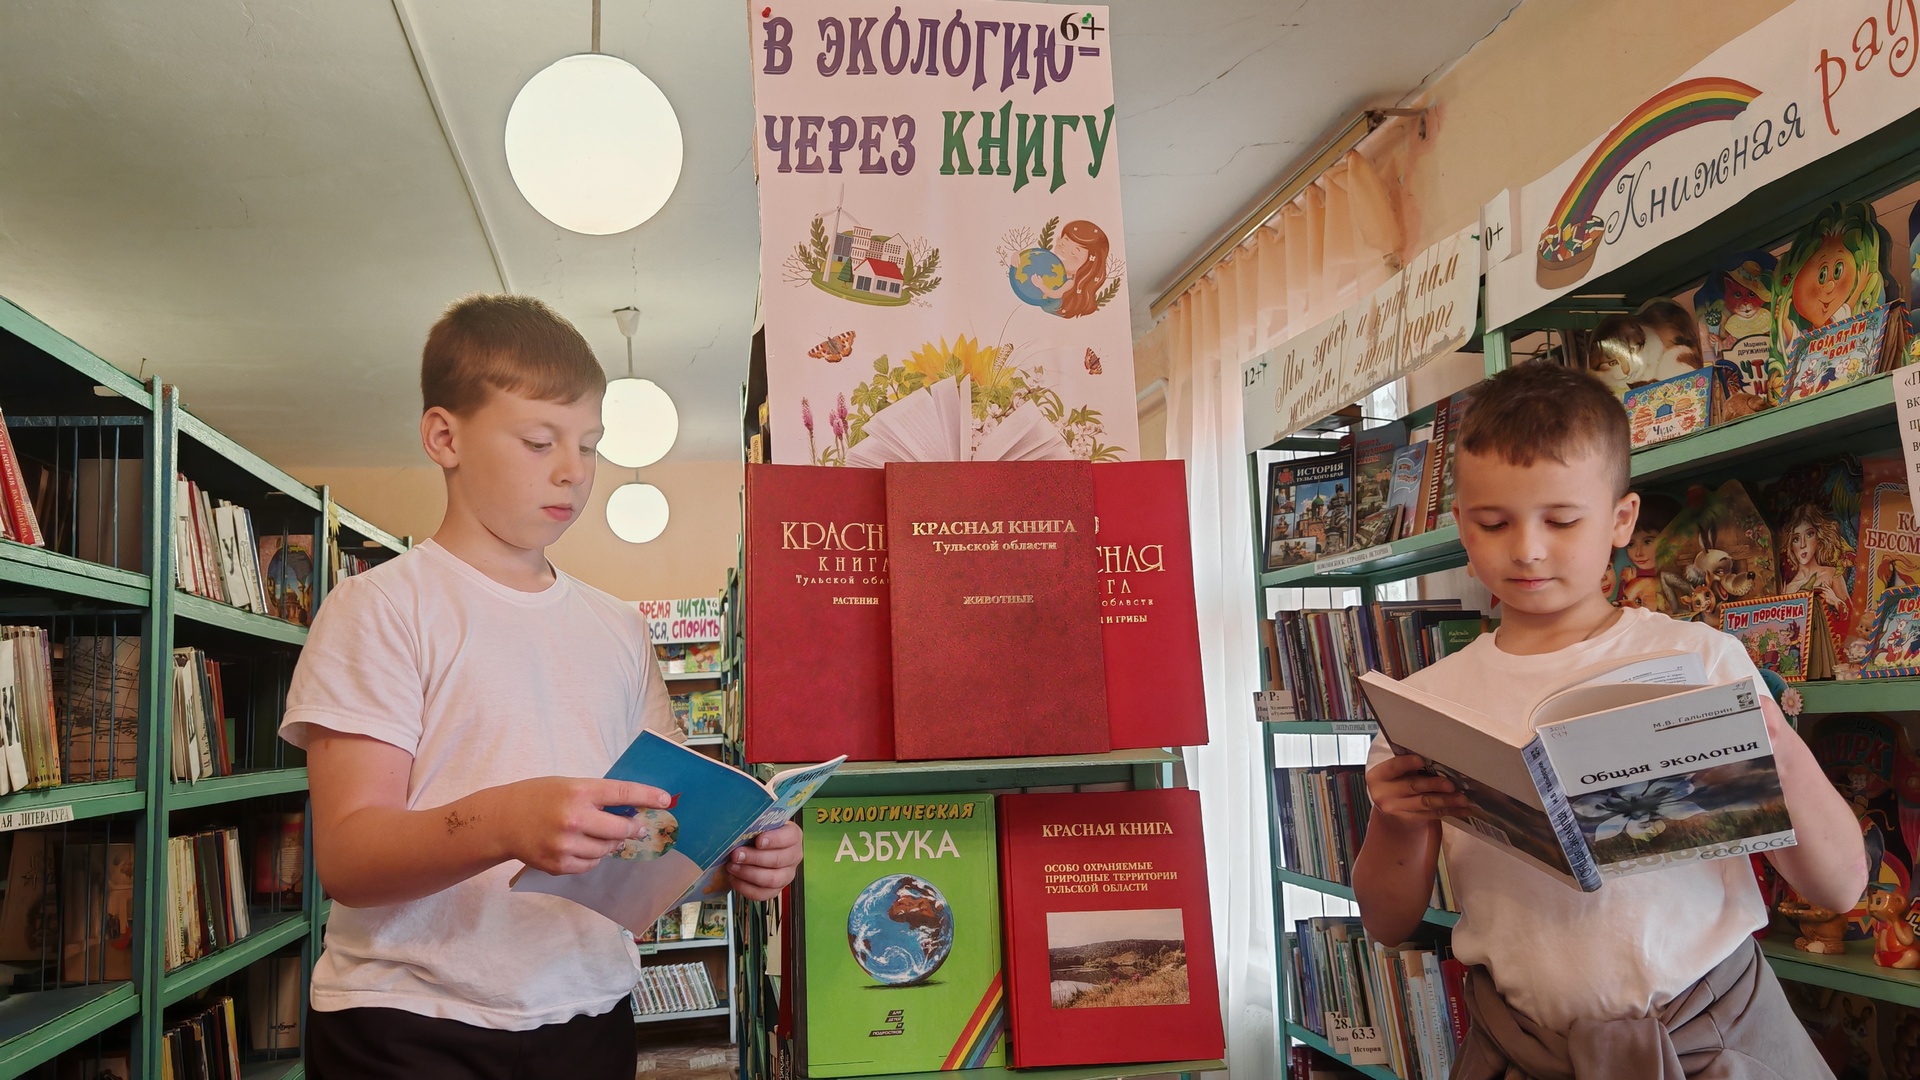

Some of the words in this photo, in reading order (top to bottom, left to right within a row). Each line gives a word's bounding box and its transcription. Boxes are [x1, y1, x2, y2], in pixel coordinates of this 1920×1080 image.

[1060, 12, 1105, 41] 6+
[763, 17, 793, 74] В
[763, 114, 916, 175] ЧЕРЕЗ
[940, 100, 1115, 193] КНИГУ
[1603, 102, 1805, 246] Книжная
[1485, 222, 1504, 251] 0+
[1312, 319, 1347, 373] здесь
[1415, 253, 1459, 299] нам
[1808, 320, 1867, 354] КОЗЛЯТКИ
[1829, 339, 1857, 360] ВОЛК
[1244, 365, 1262, 387] 12+
[1296, 474, 1329, 482] ТУЛЬСКОГО
[1297, 462, 1344, 477] ИСТОРИЯ
[912, 520, 1003, 536] КРАСНАЯ
[1008, 519, 1077, 534] КНИГА
[933, 540, 999, 555] Тульской
[1002, 540, 1057, 550] области
[796, 574, 854, 586] Тульской
[639, 600, 670, 619] ВРЕМЯ
[832, 597, 879, 605] РАСТЕНИЯ
[963, 595, 1034, 605] ЖИВОТНЫЕ
[1101, 597, 1153, 606] области
[1116, 615, 1147, 623] ГРИБЫ
[1752, 604, 1805, 624] ПОРОСЁНКА
[672, 618, 720, 639] СПОРИТЬ
[1653, 719, 1675, 729] М.В.
[1678, 707, 1733, 723] Гальперин
[1580, 764, 1652, 786] Общая
[1659, 741, 1760, 769] экология
[18, 808, 69, 827] ЛИТЕРАТУРА
[816, 802, 975, 824] ЭКОЛОГИЧЕСКАЯ
[1042, 823, 1116, 838] КРАСНАЯ
[1119, 822, 1173, 836] КНИГА
[834, 829, 961, 863] АЗБУКА
[1044, 864, 1079, 873] ОСОБО
[1083, 862, 1153, 872] ОХРАНЯЕМЫЕ
[1045, 873, 1110, 884] ПРИРОДНЫЕ
[1113, 872, 1178, 881] ТЕРРИТОРИИ
[1045, 883, 1099, 894] ТУЛЬСКОЙ
[1103, 883, 1149, 893] ОБЛАСТИ
[1352, 1028, 1376, 1040] 63.3
[1354, 1046, 1382, 1054] История
